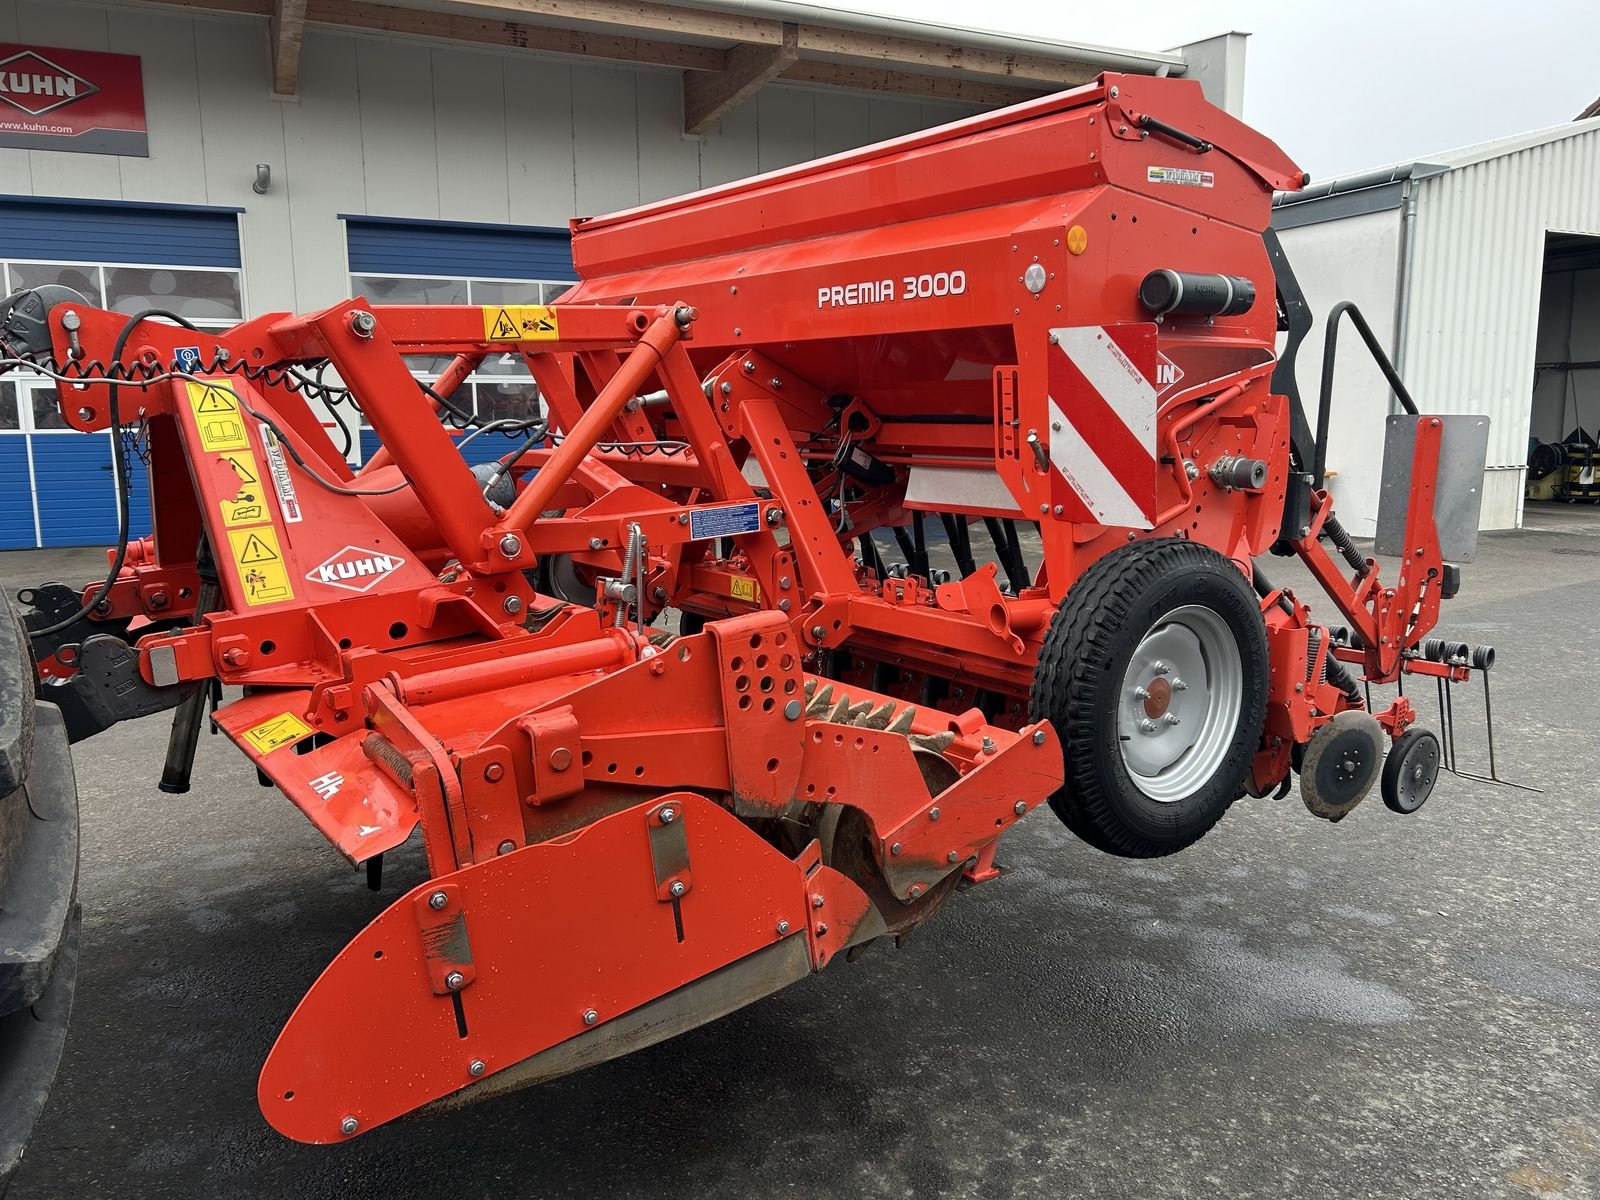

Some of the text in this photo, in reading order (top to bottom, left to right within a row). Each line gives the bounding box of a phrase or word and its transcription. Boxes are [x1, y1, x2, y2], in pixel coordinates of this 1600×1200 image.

[818, 270, 966, 308] PREMIA 3000
[318, 556, 393, 582] KUHN
